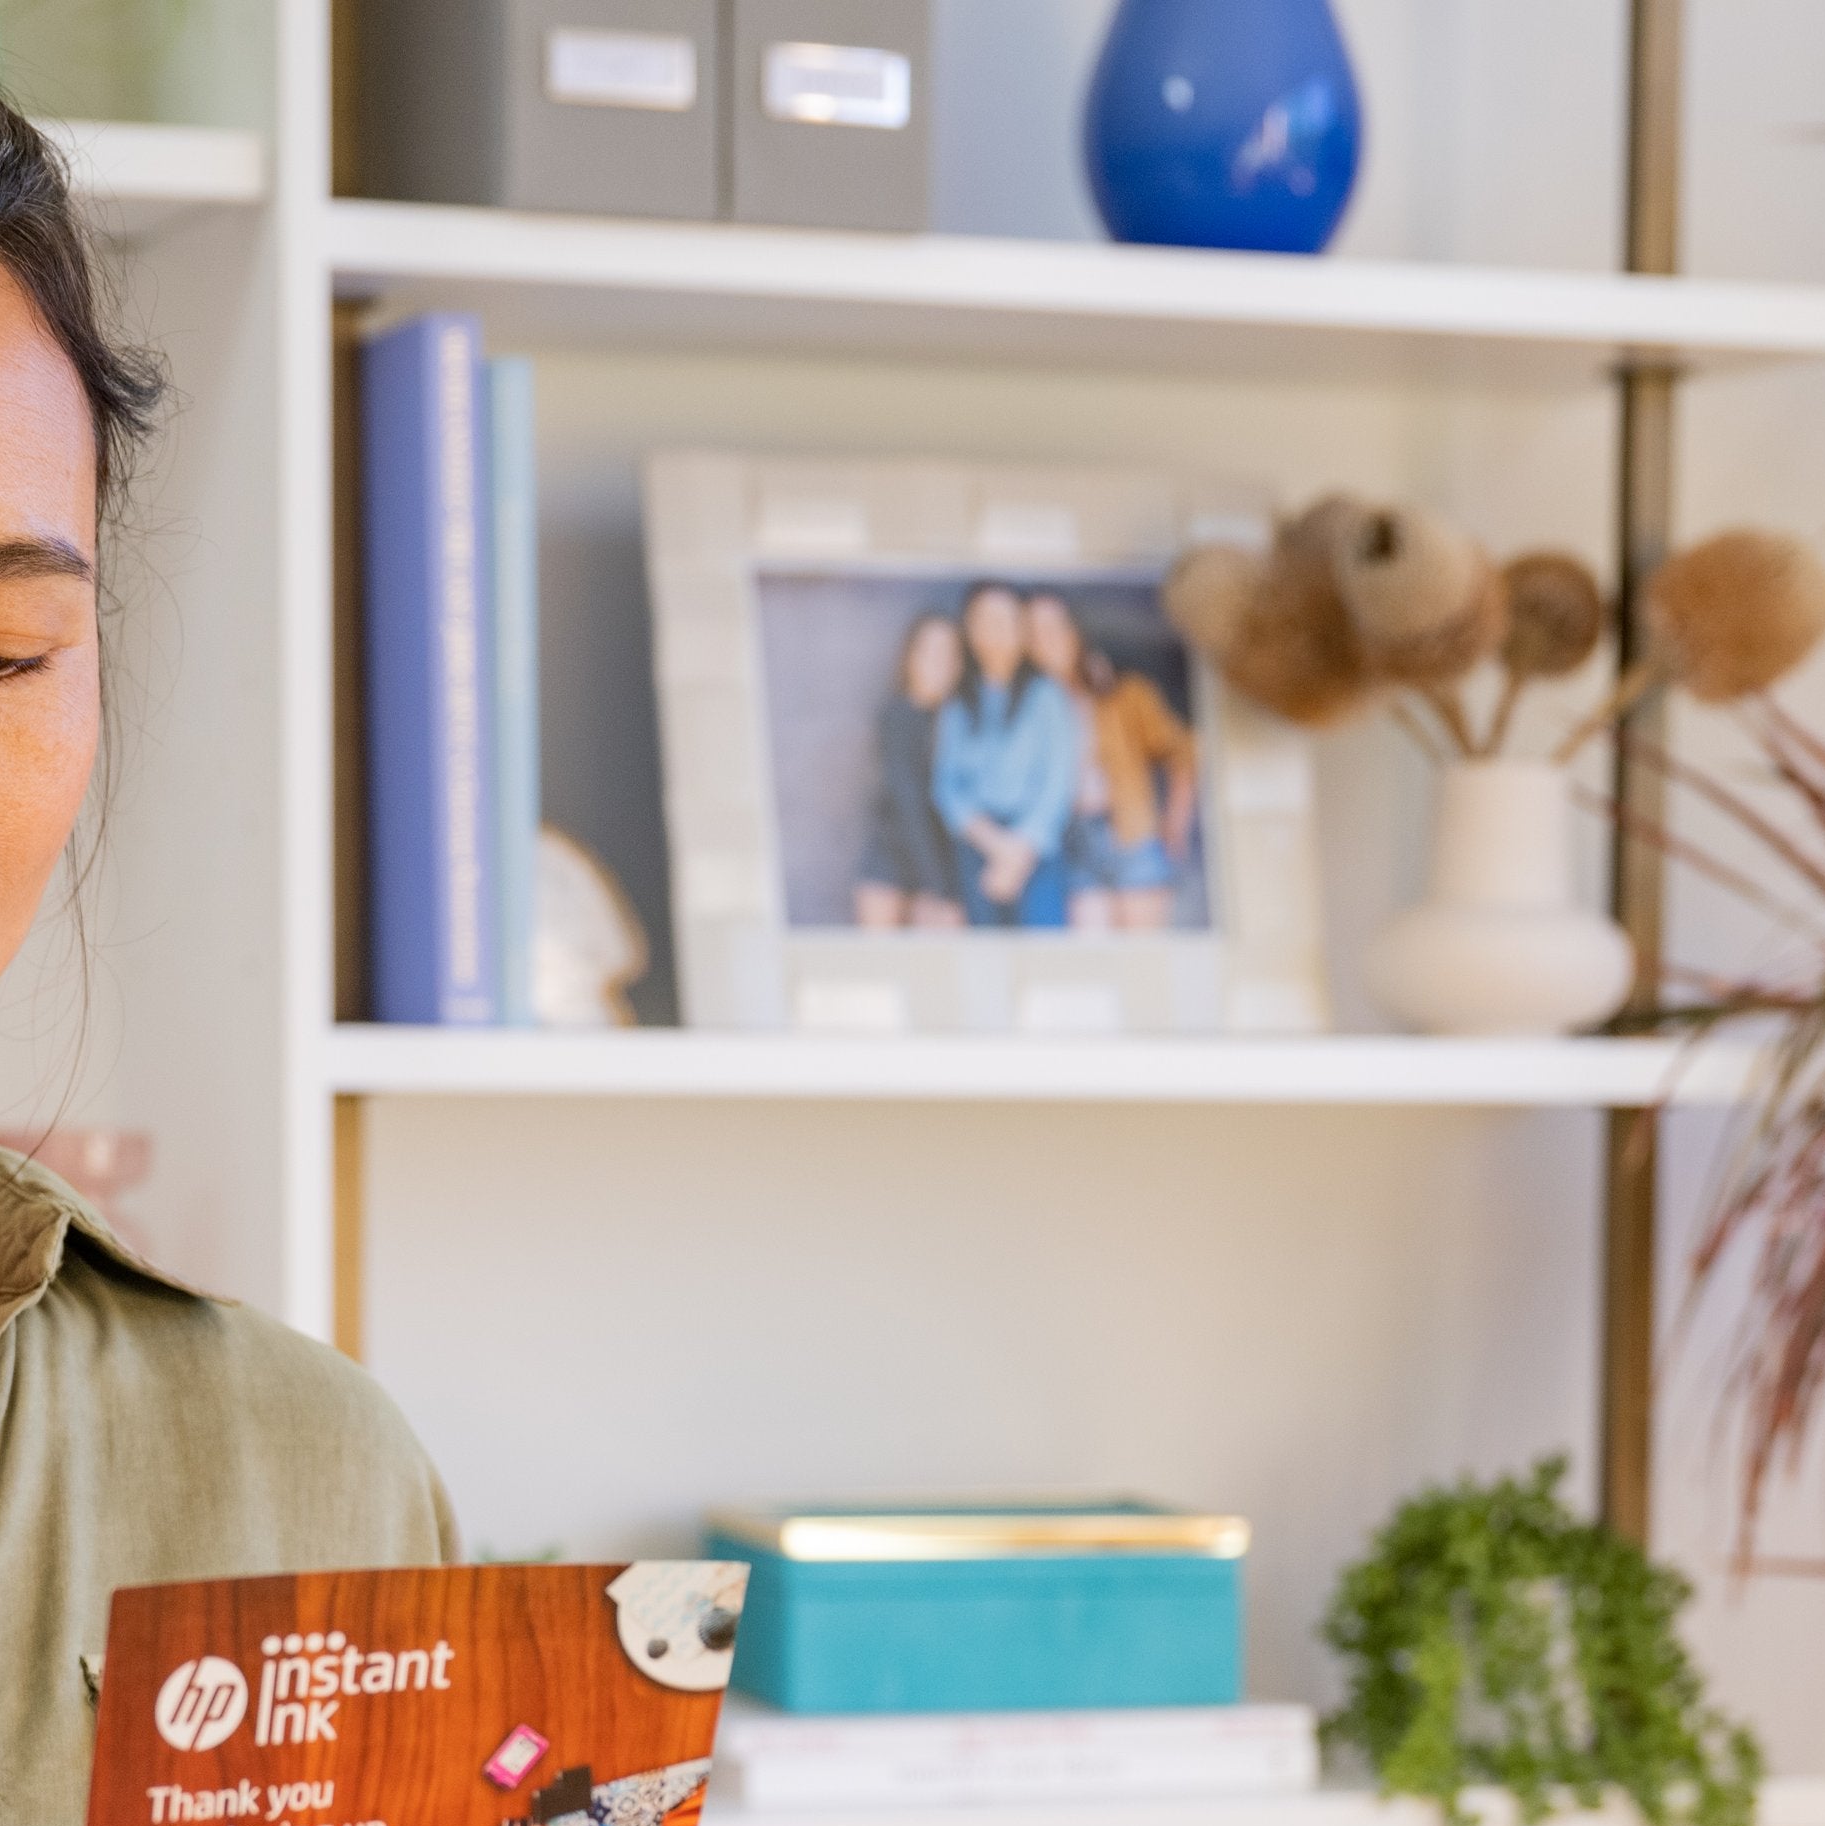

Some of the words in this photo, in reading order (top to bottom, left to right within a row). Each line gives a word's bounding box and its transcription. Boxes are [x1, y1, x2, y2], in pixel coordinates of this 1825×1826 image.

[155, 1656, 248, 1751] hp
[146, 1778, 261, 1824] Thank
[265, 1780, 335, 1821] you
